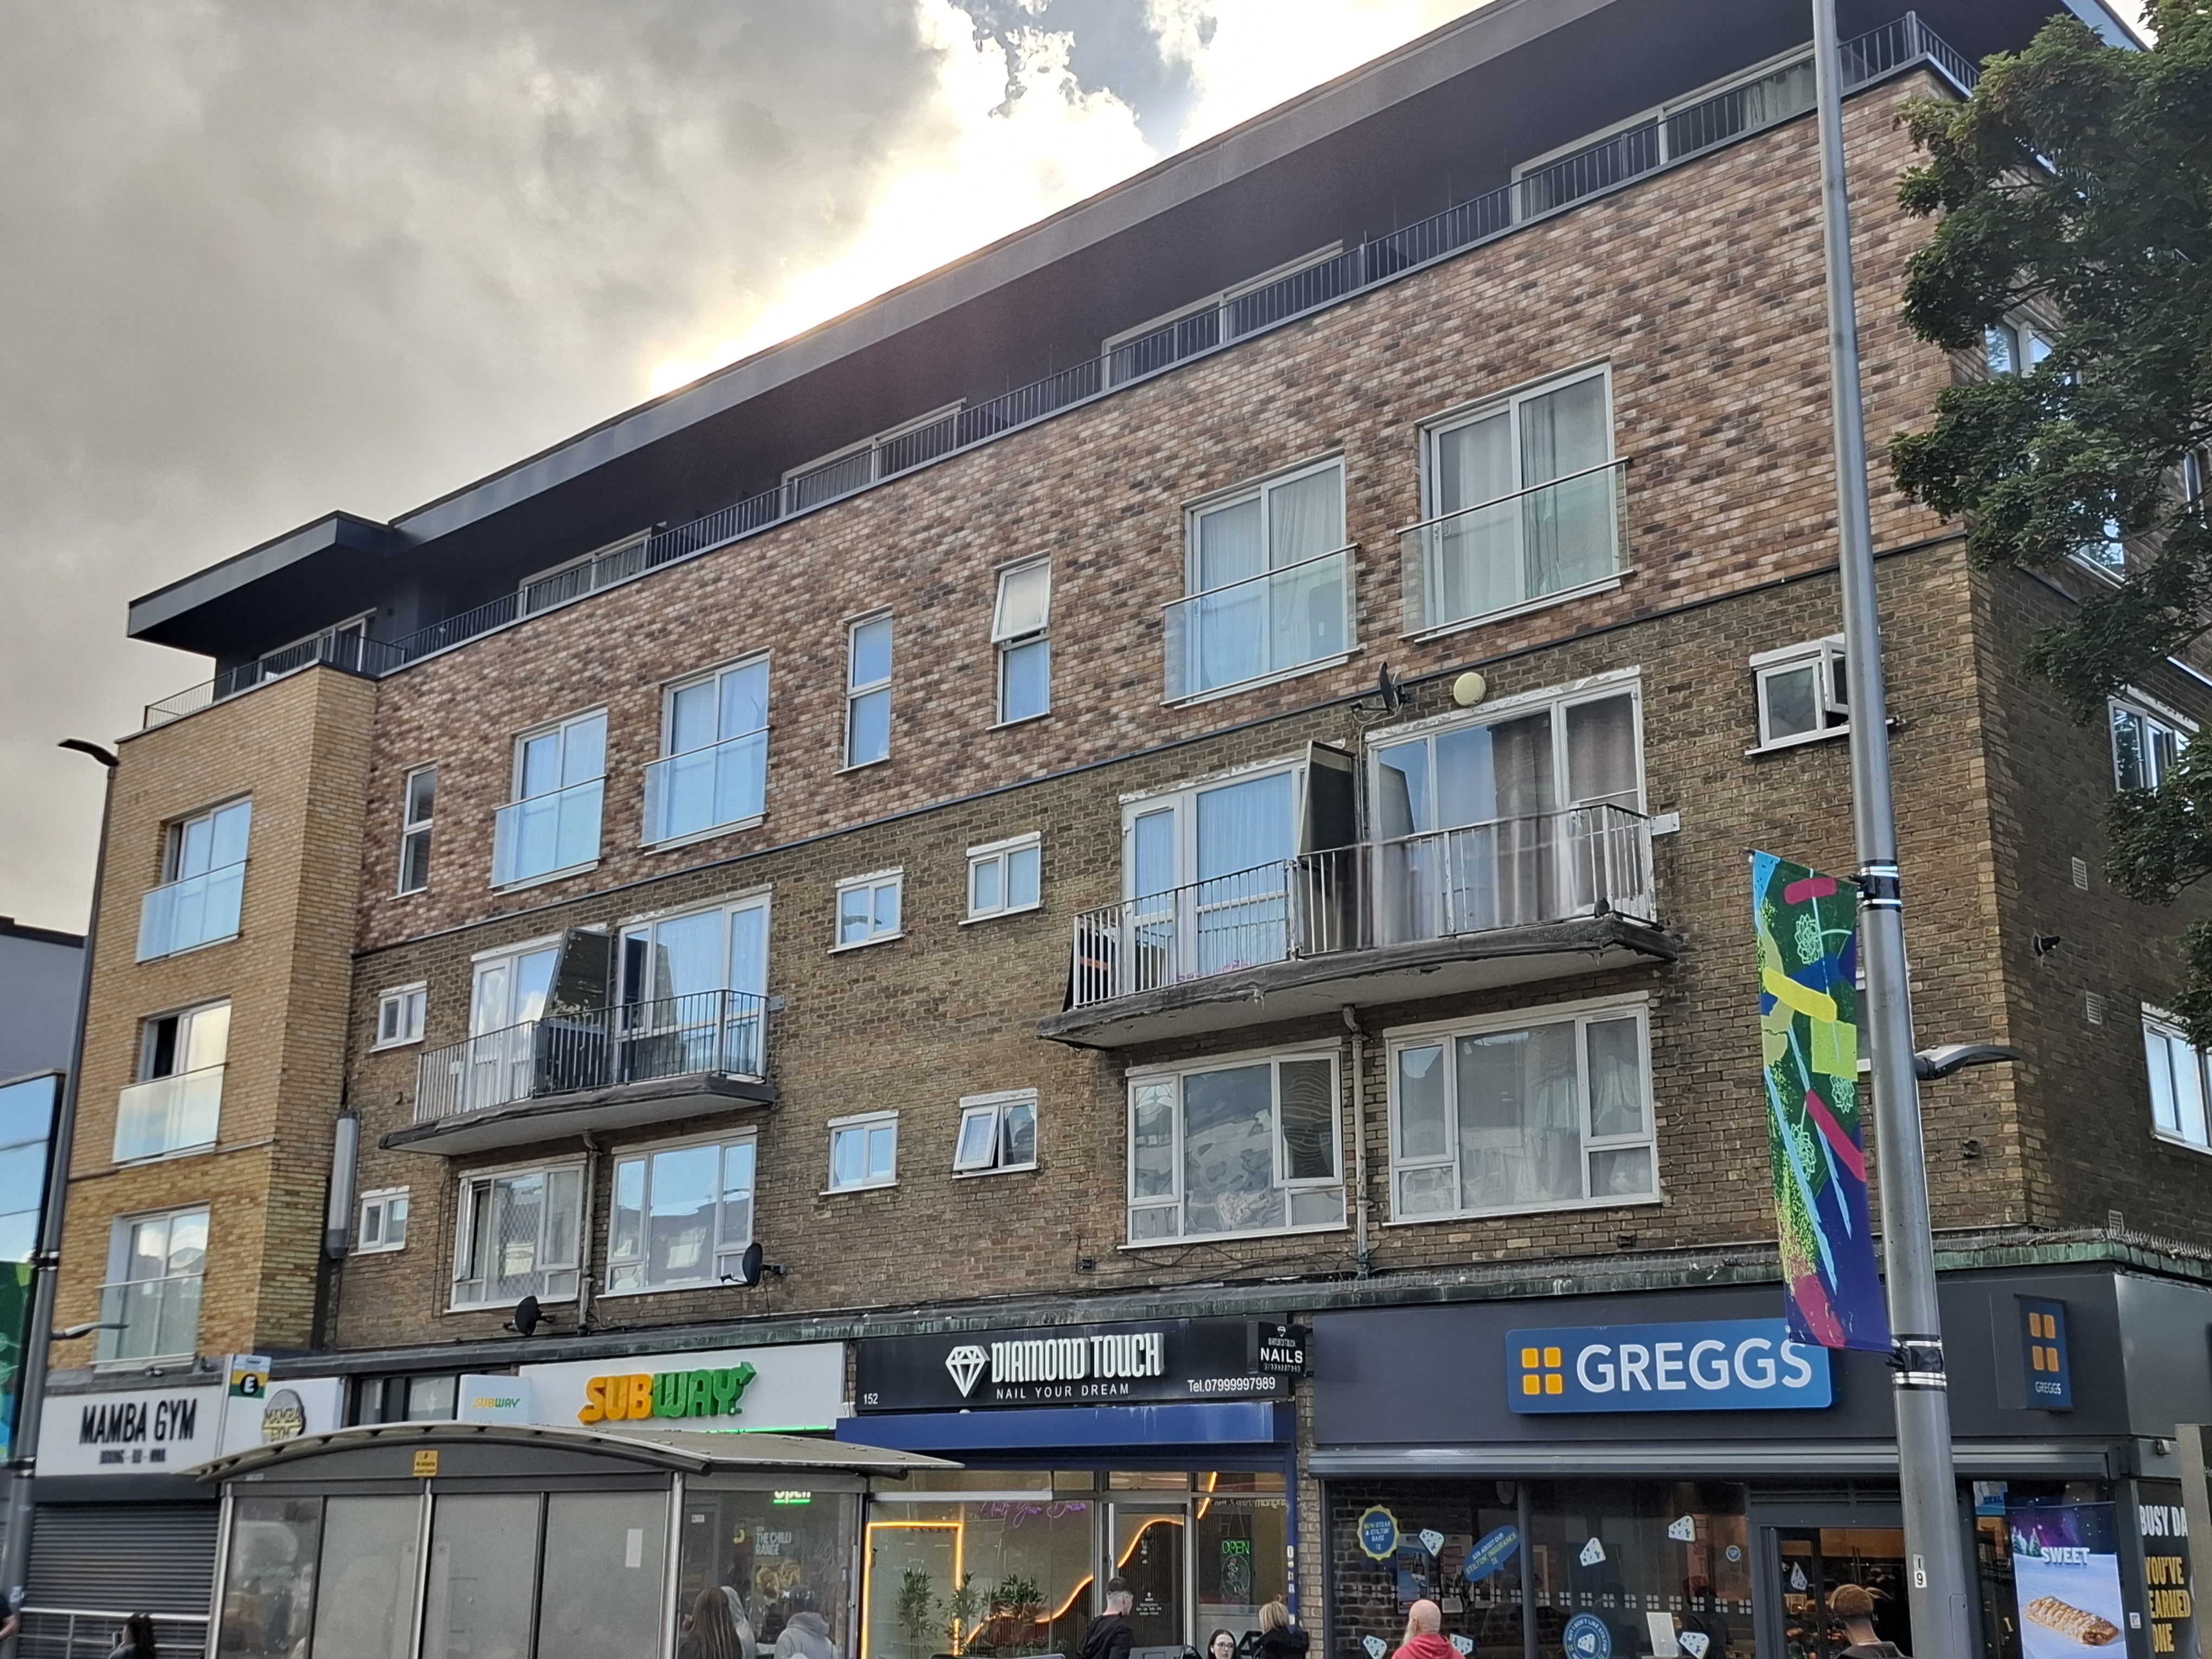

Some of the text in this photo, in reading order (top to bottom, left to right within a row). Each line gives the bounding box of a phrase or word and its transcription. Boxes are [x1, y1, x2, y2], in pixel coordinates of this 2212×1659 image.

[991, 1333, 1163, 1383] DIAMOND TOUCH
[1261, 1347, 1303, 1364] NAILS
[1576, 1338, 1812, 1393] GREGGS
[243, 1376, 256, 1393] E
[577, 1361, 757, 1425] SUBWAY
[996, 1383, 1129, 1400] NAIL YOUR DREAM
[2035, 1381, 2061, 1395] GREGGS
[472, 1397, 521, 1408] SUBWAY
[863, 1393, 878, 1405] 152
[79, 1398, 197, 1444] MAMBA GYM
[2139, 1505, 2169, 1536] BUSY
[756, 1532, 792, 1544] THE CHILLI
[756, 1544, 779, 1555] RANGE
[1222, 1541, 1250, 1554] OPEN
[2041, 1547, 2089, 1564] SWEET
[2145, 1557, 2184, 1585] YOU'VE
[2148, 1590, 2191, 1618] EARNED
[2152, 1623, 2175, 1652] ONE
